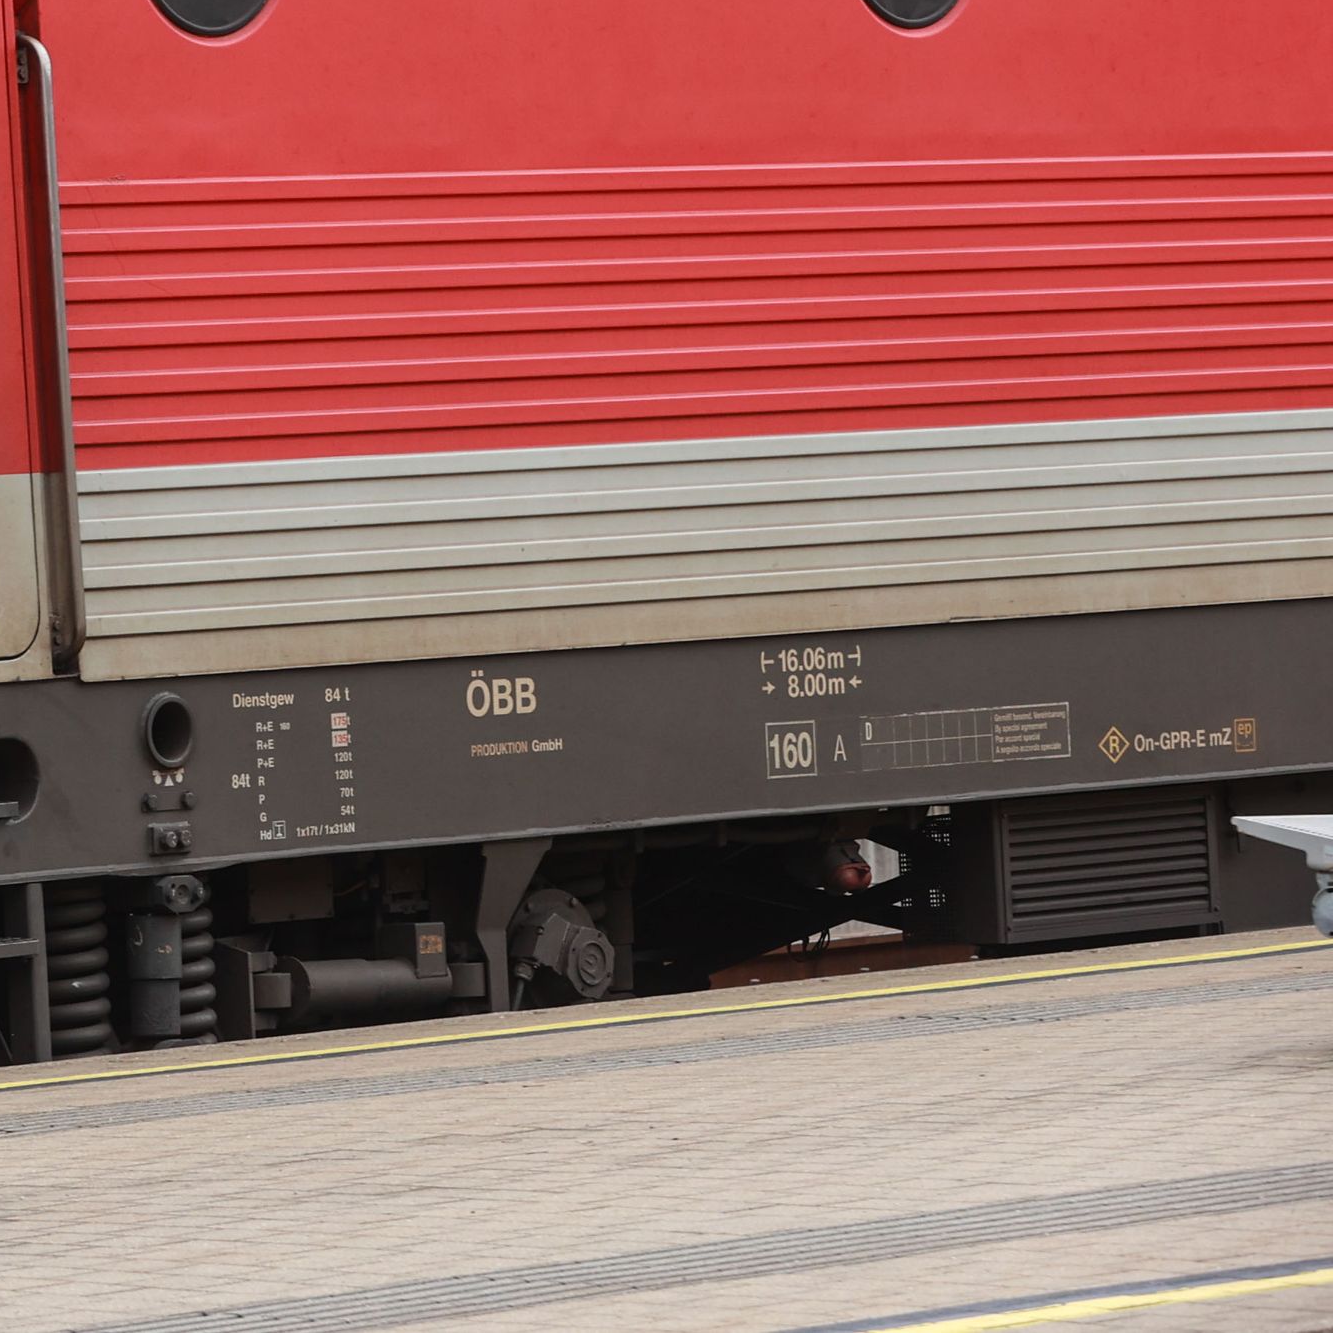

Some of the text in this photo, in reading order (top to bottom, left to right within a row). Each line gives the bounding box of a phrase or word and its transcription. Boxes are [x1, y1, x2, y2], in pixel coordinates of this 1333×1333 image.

[233, 692, 294, 708] Dienstgew
[466, 669, 537, 718] ÖBB
[865, 722, 873, 740] D
[1134, 729, 1206, 752] On-GPR-E
[471, 738, 563, 757] PRODUKTION GmbH
[769, 731, 812, 769] 160
[834, 734, 847, 761] A
[1109, 735, 1120, 754] R
